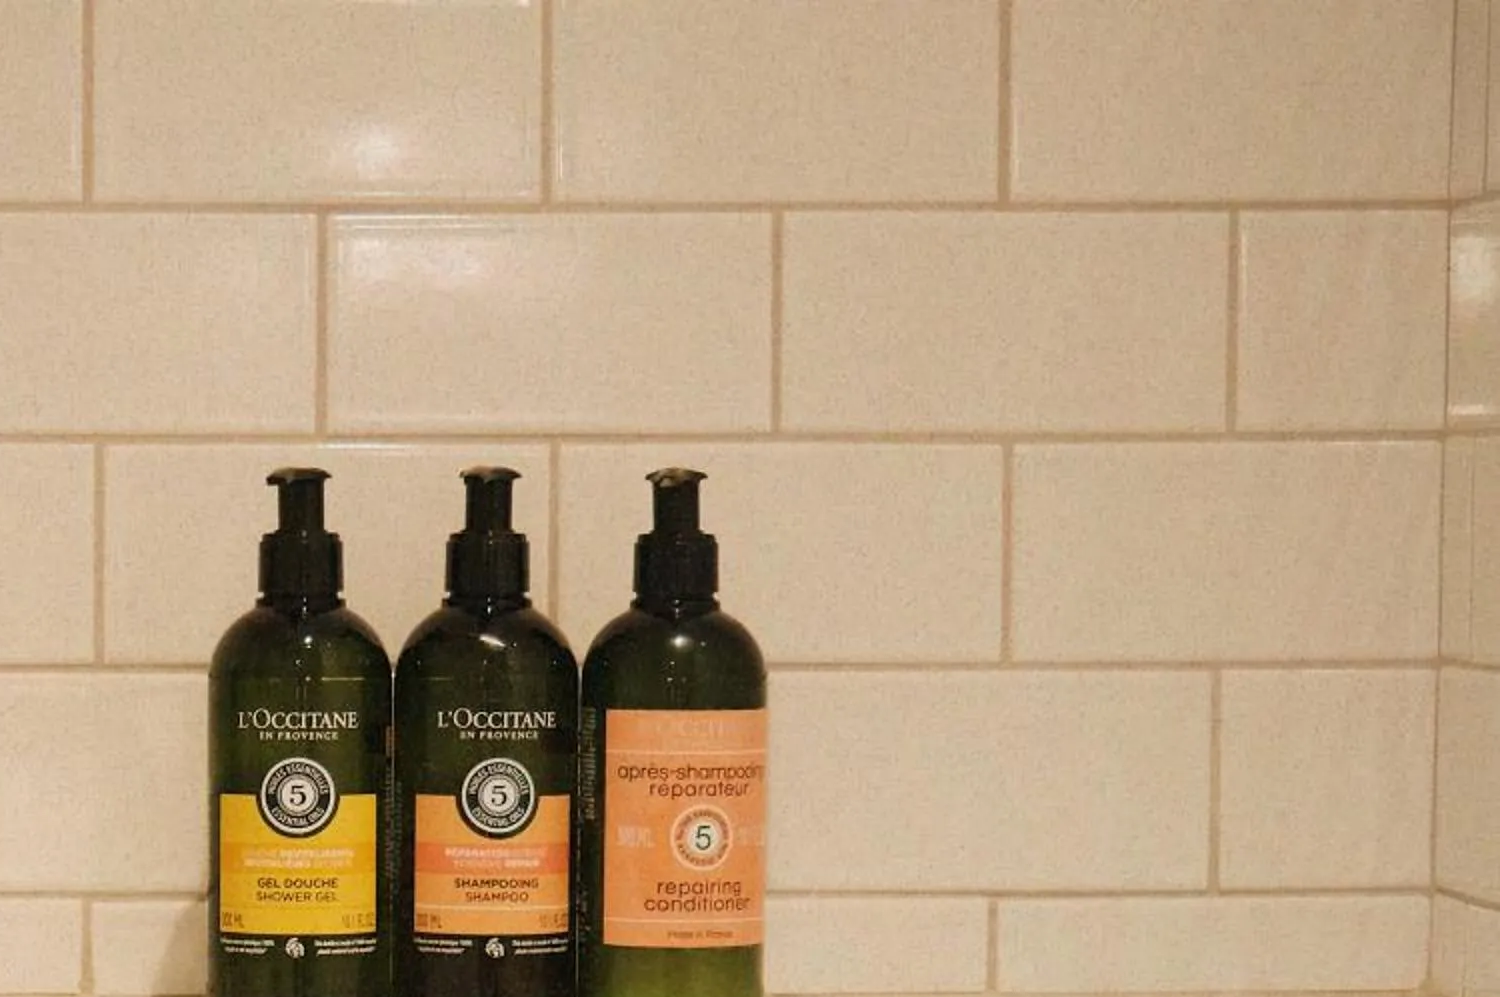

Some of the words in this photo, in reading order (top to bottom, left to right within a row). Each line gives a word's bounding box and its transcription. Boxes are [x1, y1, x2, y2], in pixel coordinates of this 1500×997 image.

[237, 708, 360, 729] L'OCCITANE
[437, 707, 557, 728] L'OCCITANE
[259, 731, 273, 741] EN
[277, 731, 339, 741] PROVENCE
[460, 731, 475, 740] EN
[479, 731, 540, 740] PROVENCE
[289, 785, 307, 806] 5
[491, 785, 507, 806] 5
[695, 825, 711, 851] 5
[257, 878, 281, 888] GEL
[283, 877, 339, 888] DOUCHE
[454, 877, 540, 889] SHAMPOOING
[656, 880, 742, 897] repairing
[256, 891, 312, 902] SHOWER
[315, 891, 338, 901] GEL
[465, 891, 529, 902] SHAMPOO
[643, 897, 751, 912] conditioner
